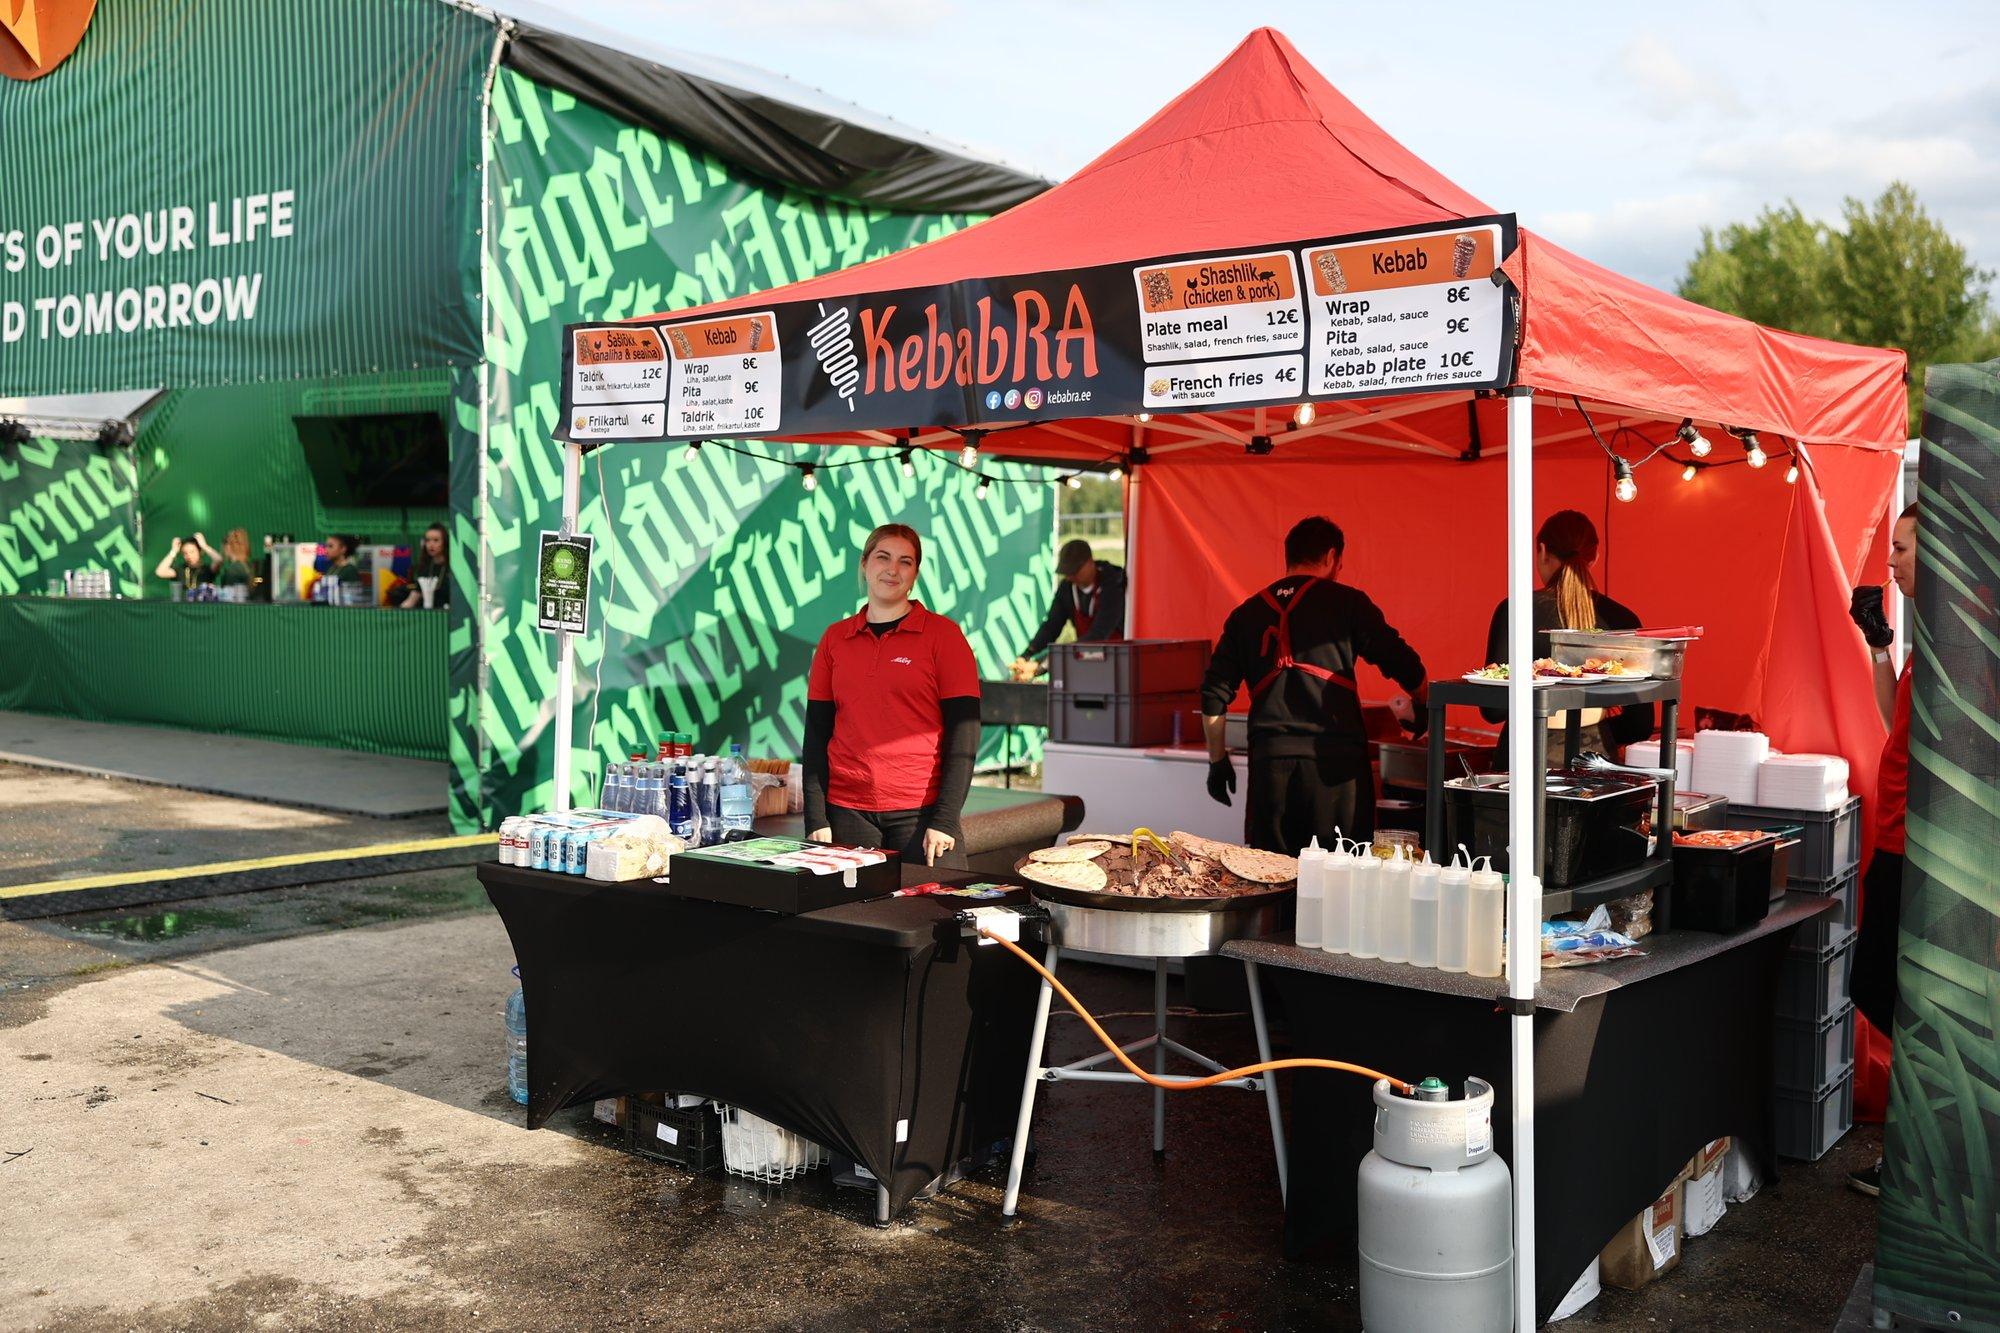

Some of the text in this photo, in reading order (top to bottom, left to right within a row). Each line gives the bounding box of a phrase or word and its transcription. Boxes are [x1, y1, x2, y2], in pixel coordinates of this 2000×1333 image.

[0, 189, 294, 272] S OF YOUR LIFE
[1372, 248, 1428, 275] Kebab
[1200, 263, 1259, 286] Shashlik
[1184, 281, 1281, 309] (chicken & pork)
[1326, 286, 1470, 316] Wrap 8€
[2, 273, 262, 343] D TOMORROW
[1330, 310, 1429, 327] Kebab, salad, sauce
[1146, 309, 1299, 337] Plate meal 12€
[1326, 318, 1470, 345] Pita 9€
[704, 327, 737, 346] Kebab
[859, 283, 1099, 395] KebabRA
[1147, 331, 1298, 352] Shashlik, salad, french fries, sauce
[624, 348, 631, 360] &
[1330, 341, 1429, 357] Kebab, salad, sauce
[642, 367, 662, 379] 12€
[684, 357, 758, 375] Wrap 8€
[1324, 351, 1474, 378] Kebab plate 10€
[682, 381, 759, 397] Pita 9€
[1170, 367, 1296, 391] French fries 4€
[1323, 369, 1482, 390] Kebab, salad, french fries sauce
[1047, 389, 1092, 405] kebabra.ee
[1172, 391, 1215, 400] with sauce
[641, 413, 655, 425] 4€
[681, 407, 764, 422] Taldrik 10€
